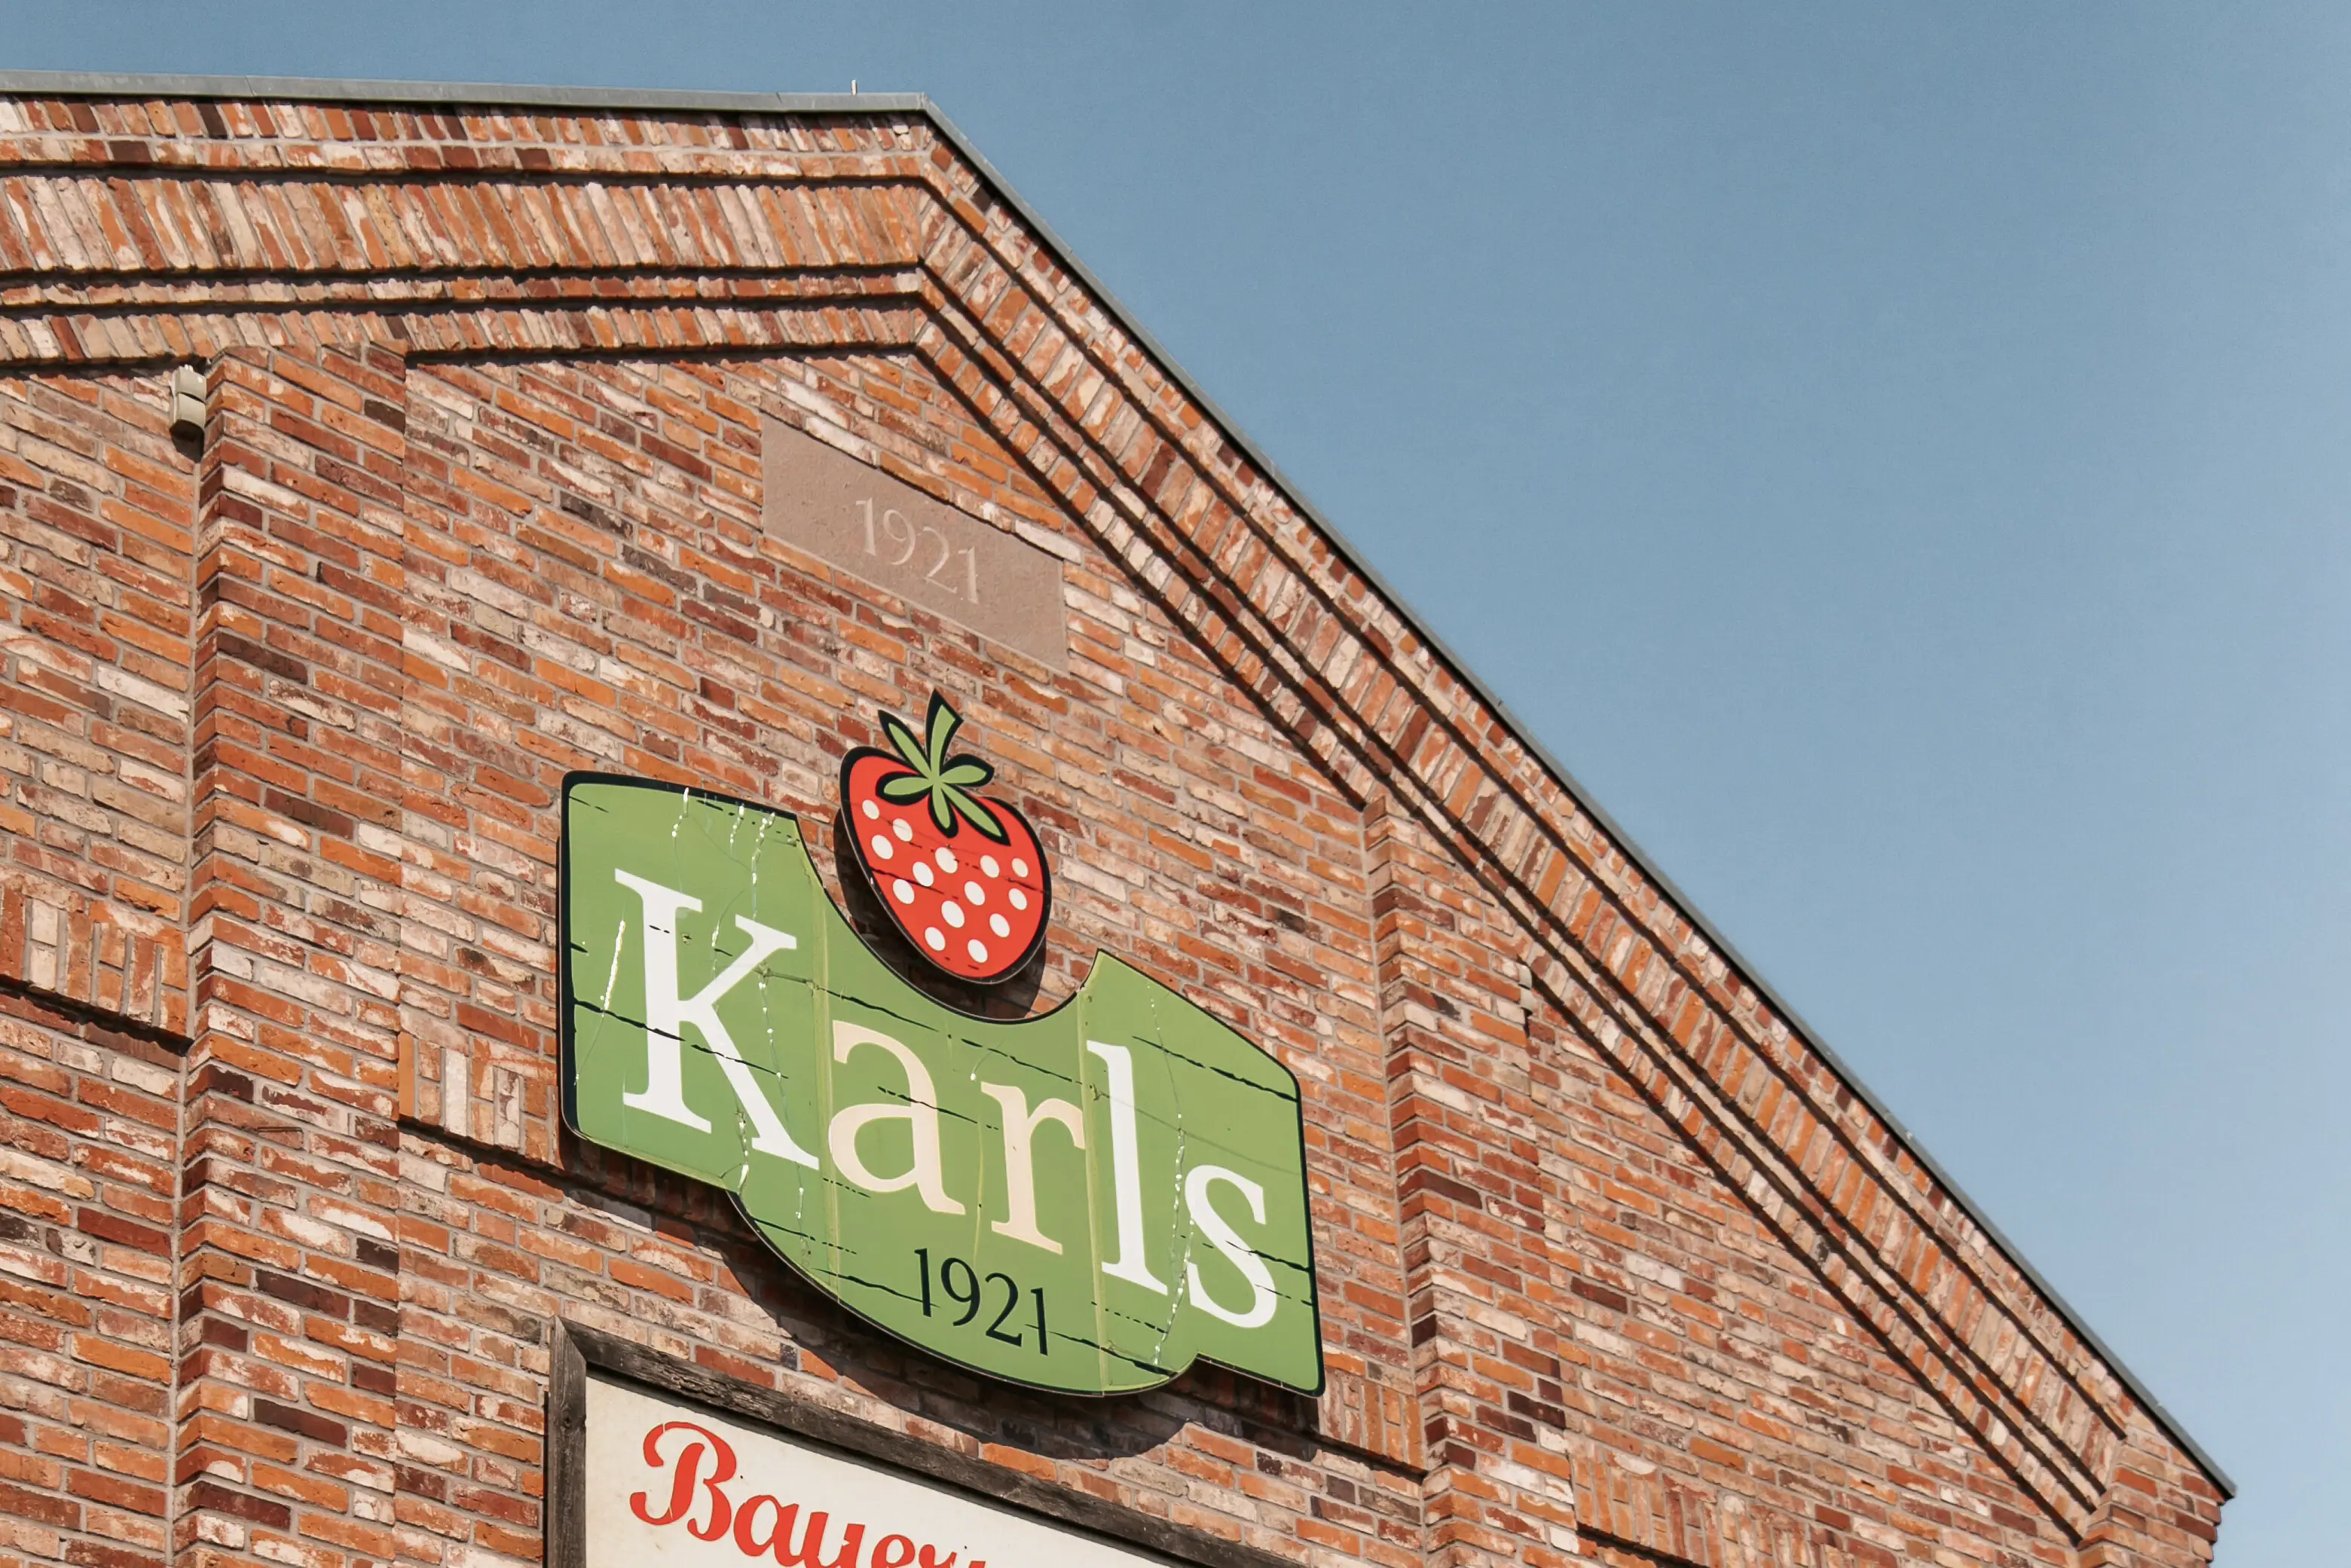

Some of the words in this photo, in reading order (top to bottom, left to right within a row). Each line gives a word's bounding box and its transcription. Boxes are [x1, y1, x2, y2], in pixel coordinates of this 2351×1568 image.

[855, 497, 980, 604] 1921
[614, 868, 1276, 1328] Karls
[914, 1248, 1047, 1356] 1921
